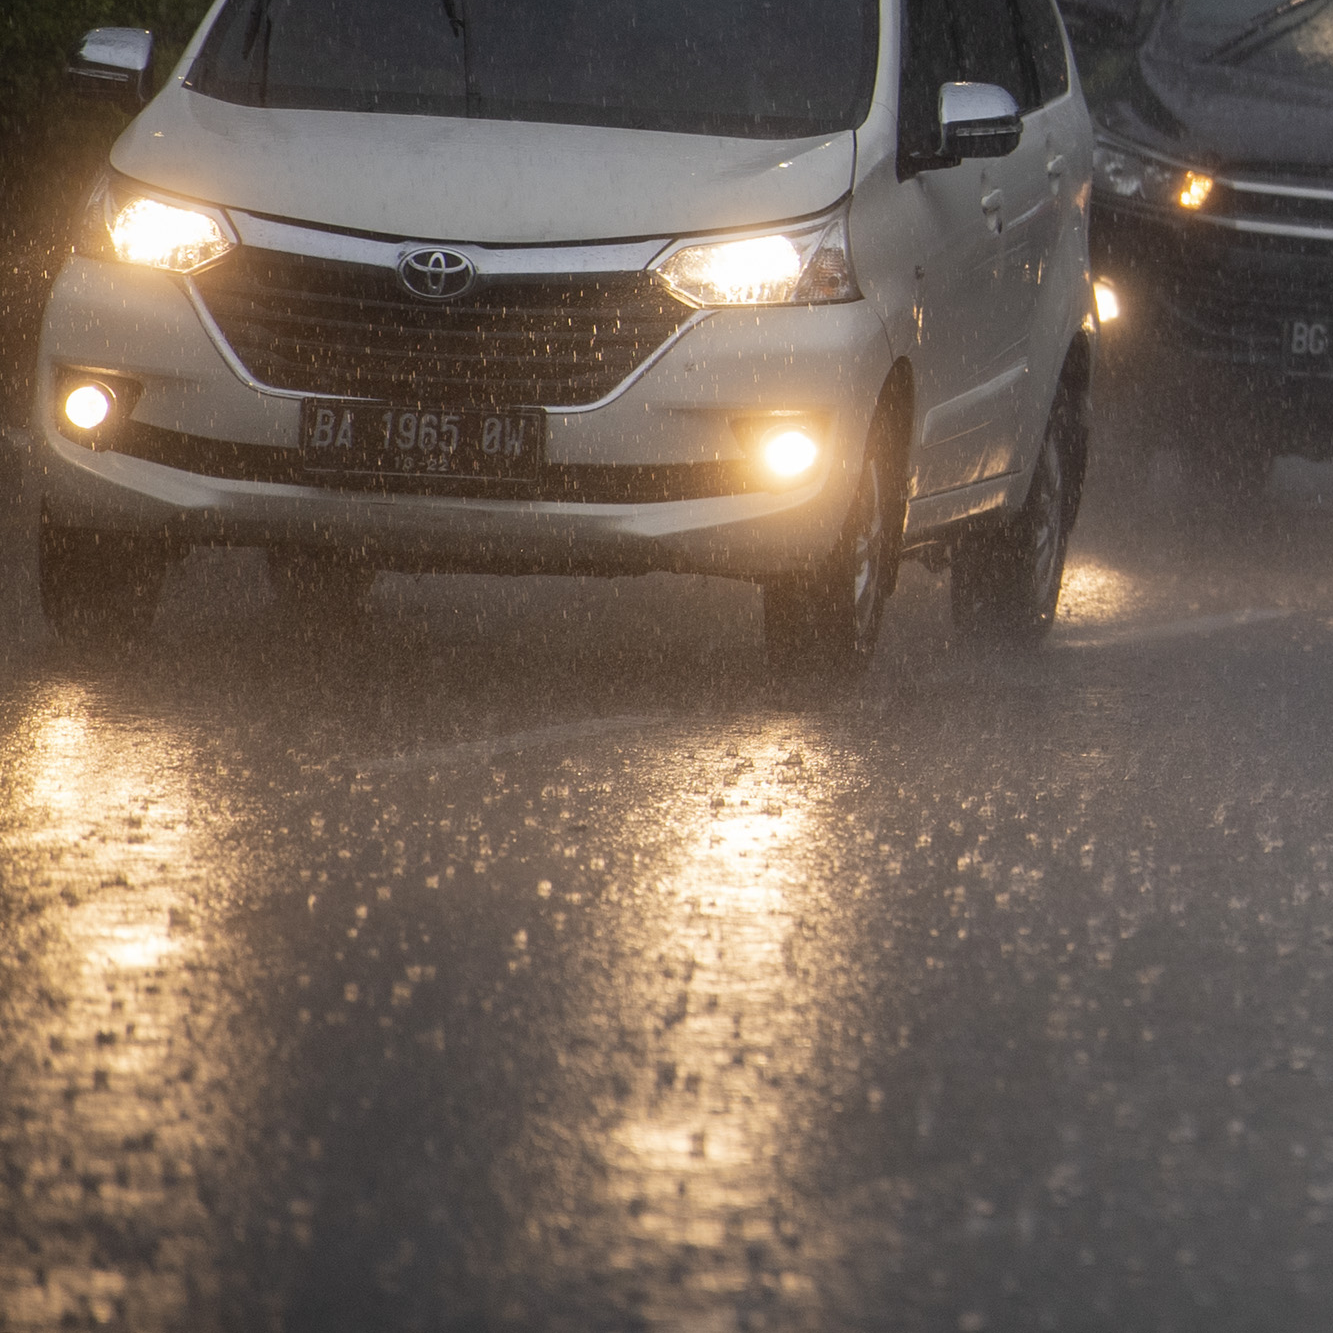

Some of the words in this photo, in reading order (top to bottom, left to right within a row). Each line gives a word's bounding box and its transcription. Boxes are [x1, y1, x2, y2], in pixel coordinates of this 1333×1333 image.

[1291, 322, 1328, 355] BG
[311, 409, 354, 448] BA
[379, 410, 461, 453] 1965
